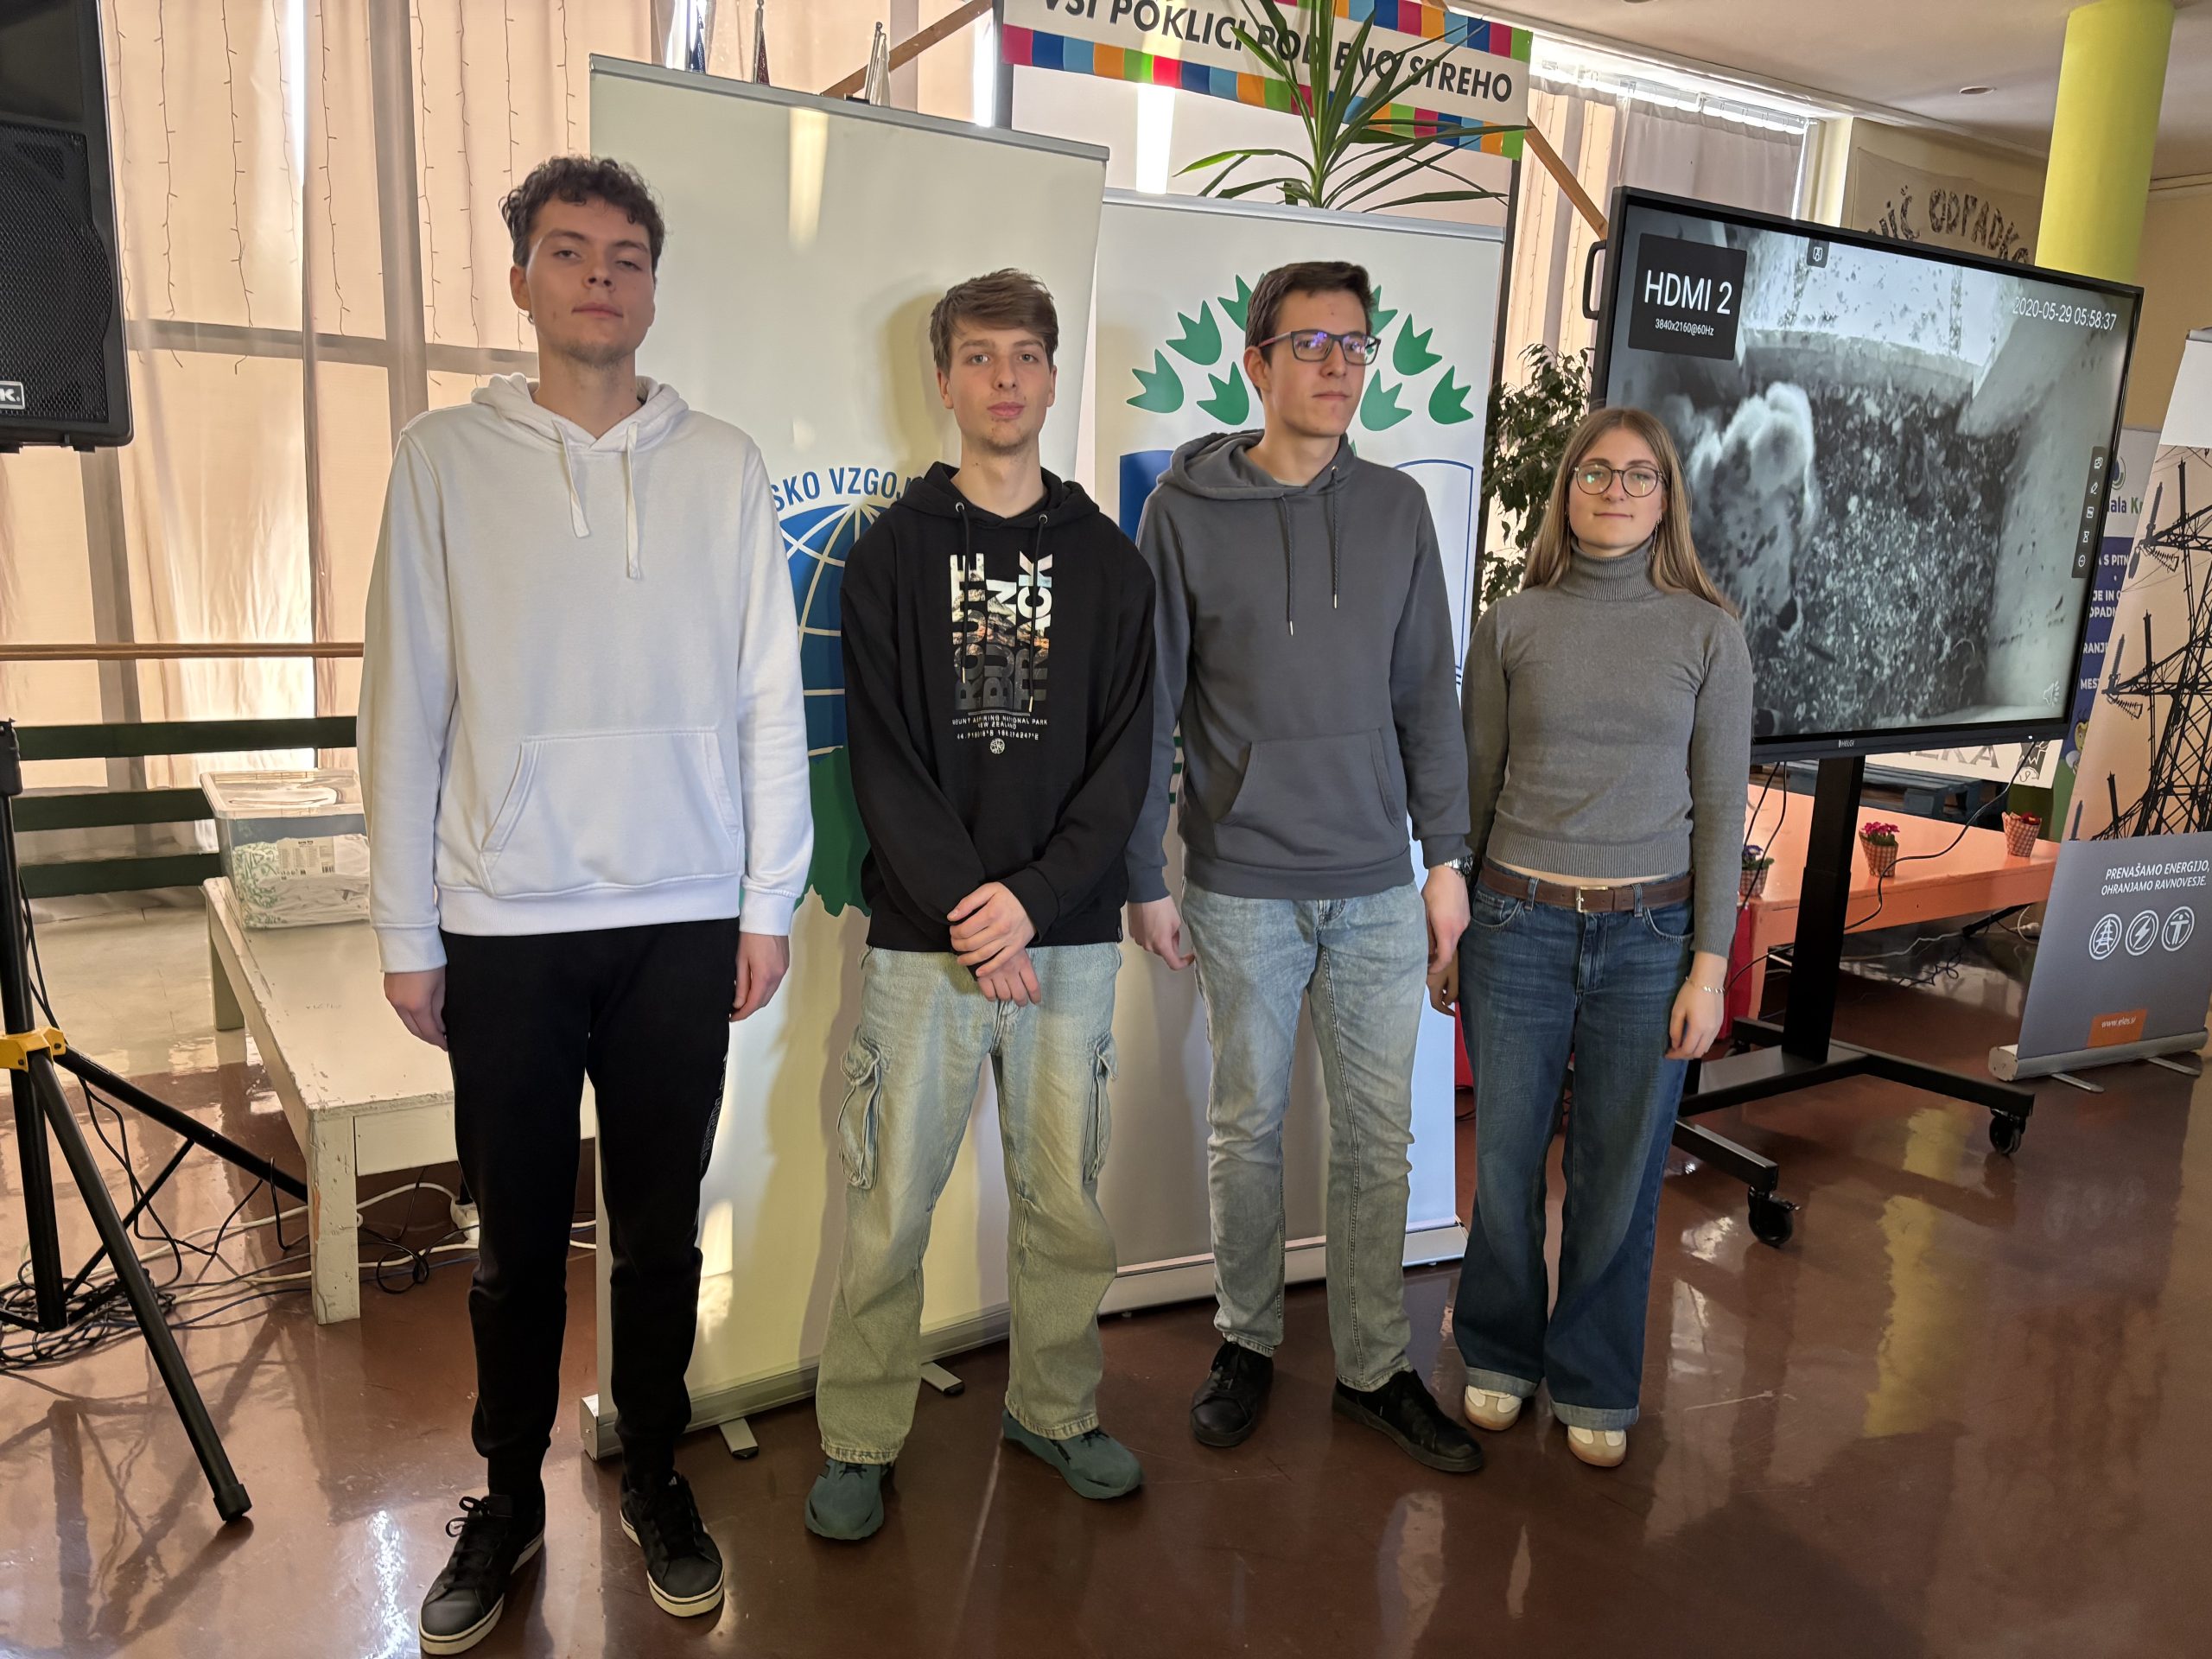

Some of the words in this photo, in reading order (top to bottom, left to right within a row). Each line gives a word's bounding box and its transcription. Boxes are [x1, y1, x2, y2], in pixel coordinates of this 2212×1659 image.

[1109, 0, 1247, 51] POKLICI
[1408, 55, 1512, 103] STREHO
[1644, 270, 1712, 312] HDMI
[1717, 281, 1732, 315] 2
[1655, 318, 1714, 336] 3840x2160@60Hz
[2012, 296, 2072, 323] 2020-05-29
[2074, 307, 2117, 331] 05:58:37
[2108, 496, 2127, 513] ala
[2105, 589, 2114, 601] IN
[950, 553, 987, 710] ROUTE
[982, 579, 1017, 710] BURN
[1013, 550, 1053, 711] TRACK
[2081, 677, 2100, 690] MES
[2106, 862, 2163, 880] PRENAŠAMO
[2164, 860, 2209, 874] ENERGIJO,
[2101, 880, 2153, 896] OHRANJAMO
[2155, 875, 2207, 890] RAVNOVESJE.
